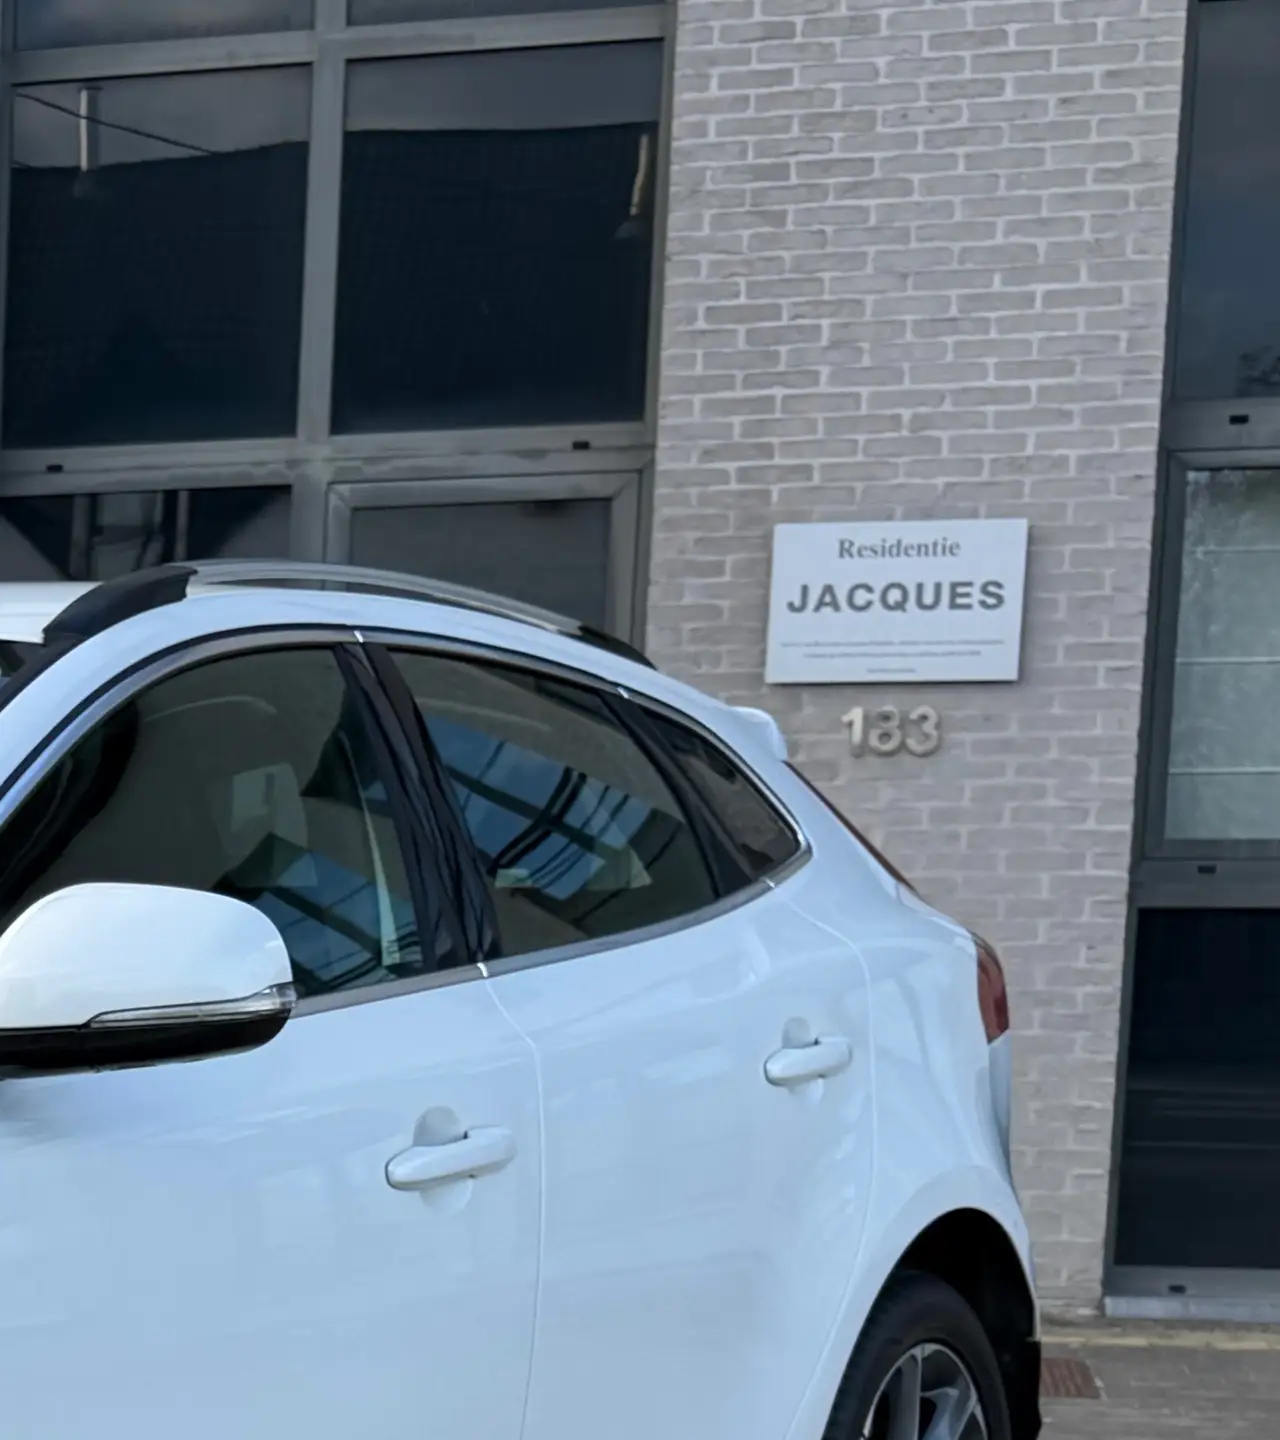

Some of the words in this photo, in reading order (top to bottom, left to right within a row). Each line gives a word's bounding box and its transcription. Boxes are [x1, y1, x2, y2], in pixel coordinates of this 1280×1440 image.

[837, 537, 961, 560] Residentie
[786, 579, 1006, 613] JACQUES
[840, 703, 940, 758] 183
